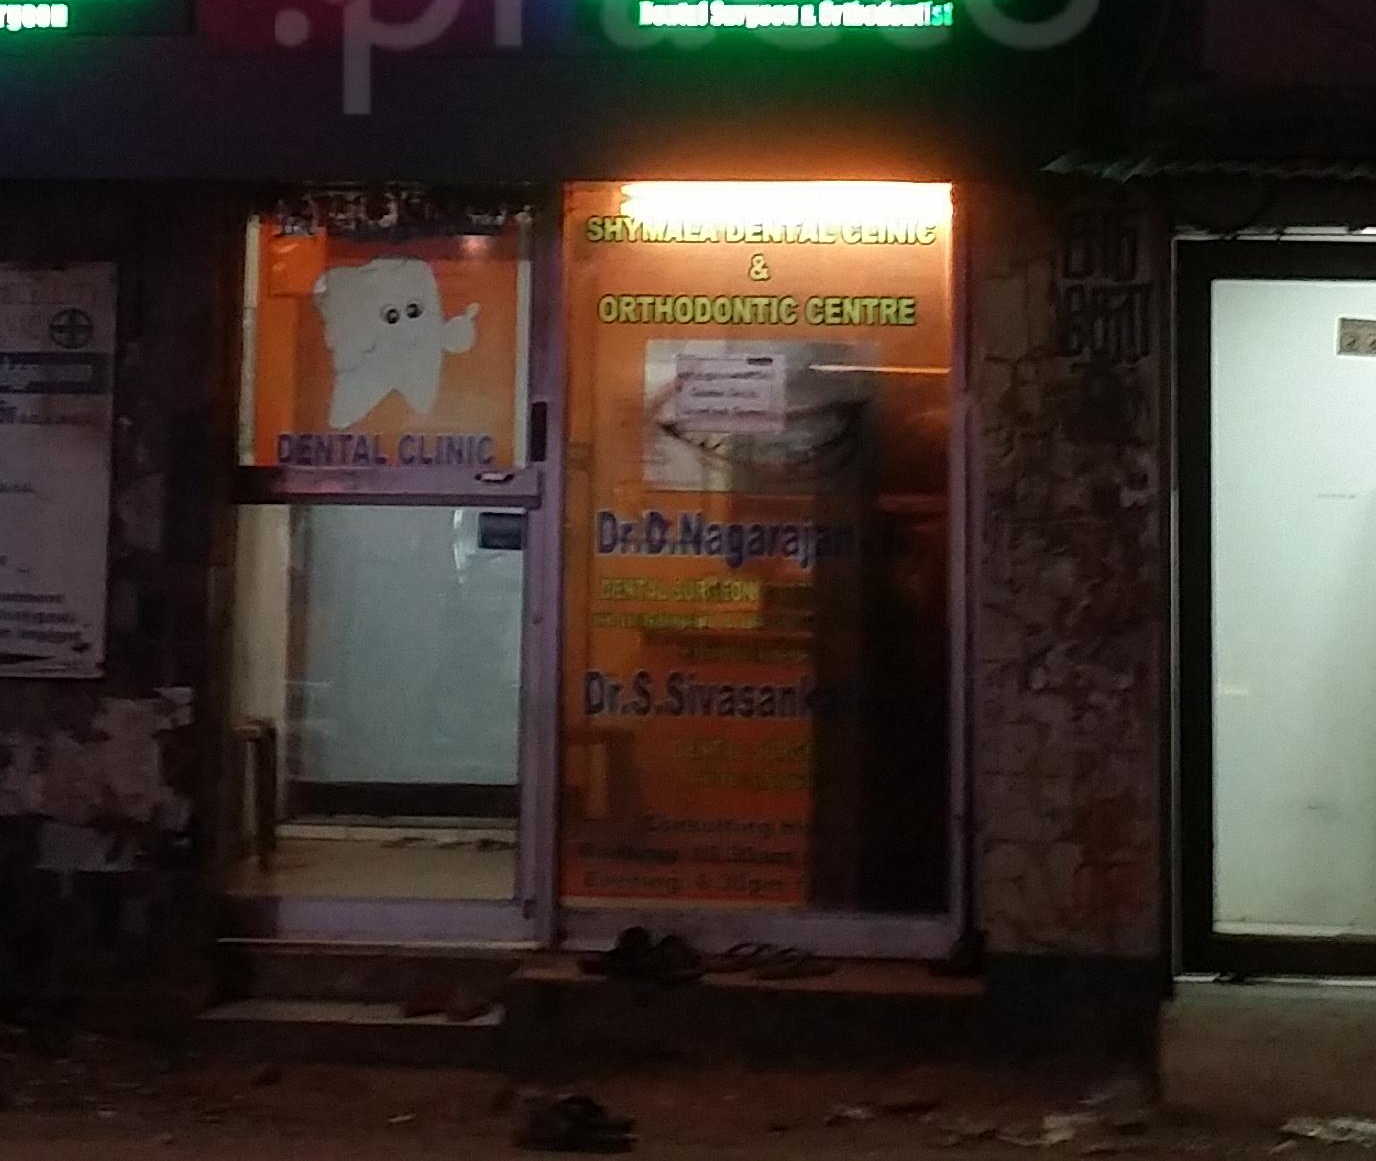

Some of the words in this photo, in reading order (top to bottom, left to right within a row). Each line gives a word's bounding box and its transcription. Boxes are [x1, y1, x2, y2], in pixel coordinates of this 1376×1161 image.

[586, 213, 717, 244] SHYMALA
[723, 215, 835, 245] DENTAL
[840, 217, 937, 246] CLINIC
[747, 254, 771, 281] &
[597, 293, 800, 325] ORTHODONTIC
[804, 295, 917, 327] CENTRE
[278, 433, 388, 465] DENTAL
[397, 434, 493, 465] CLINIC
